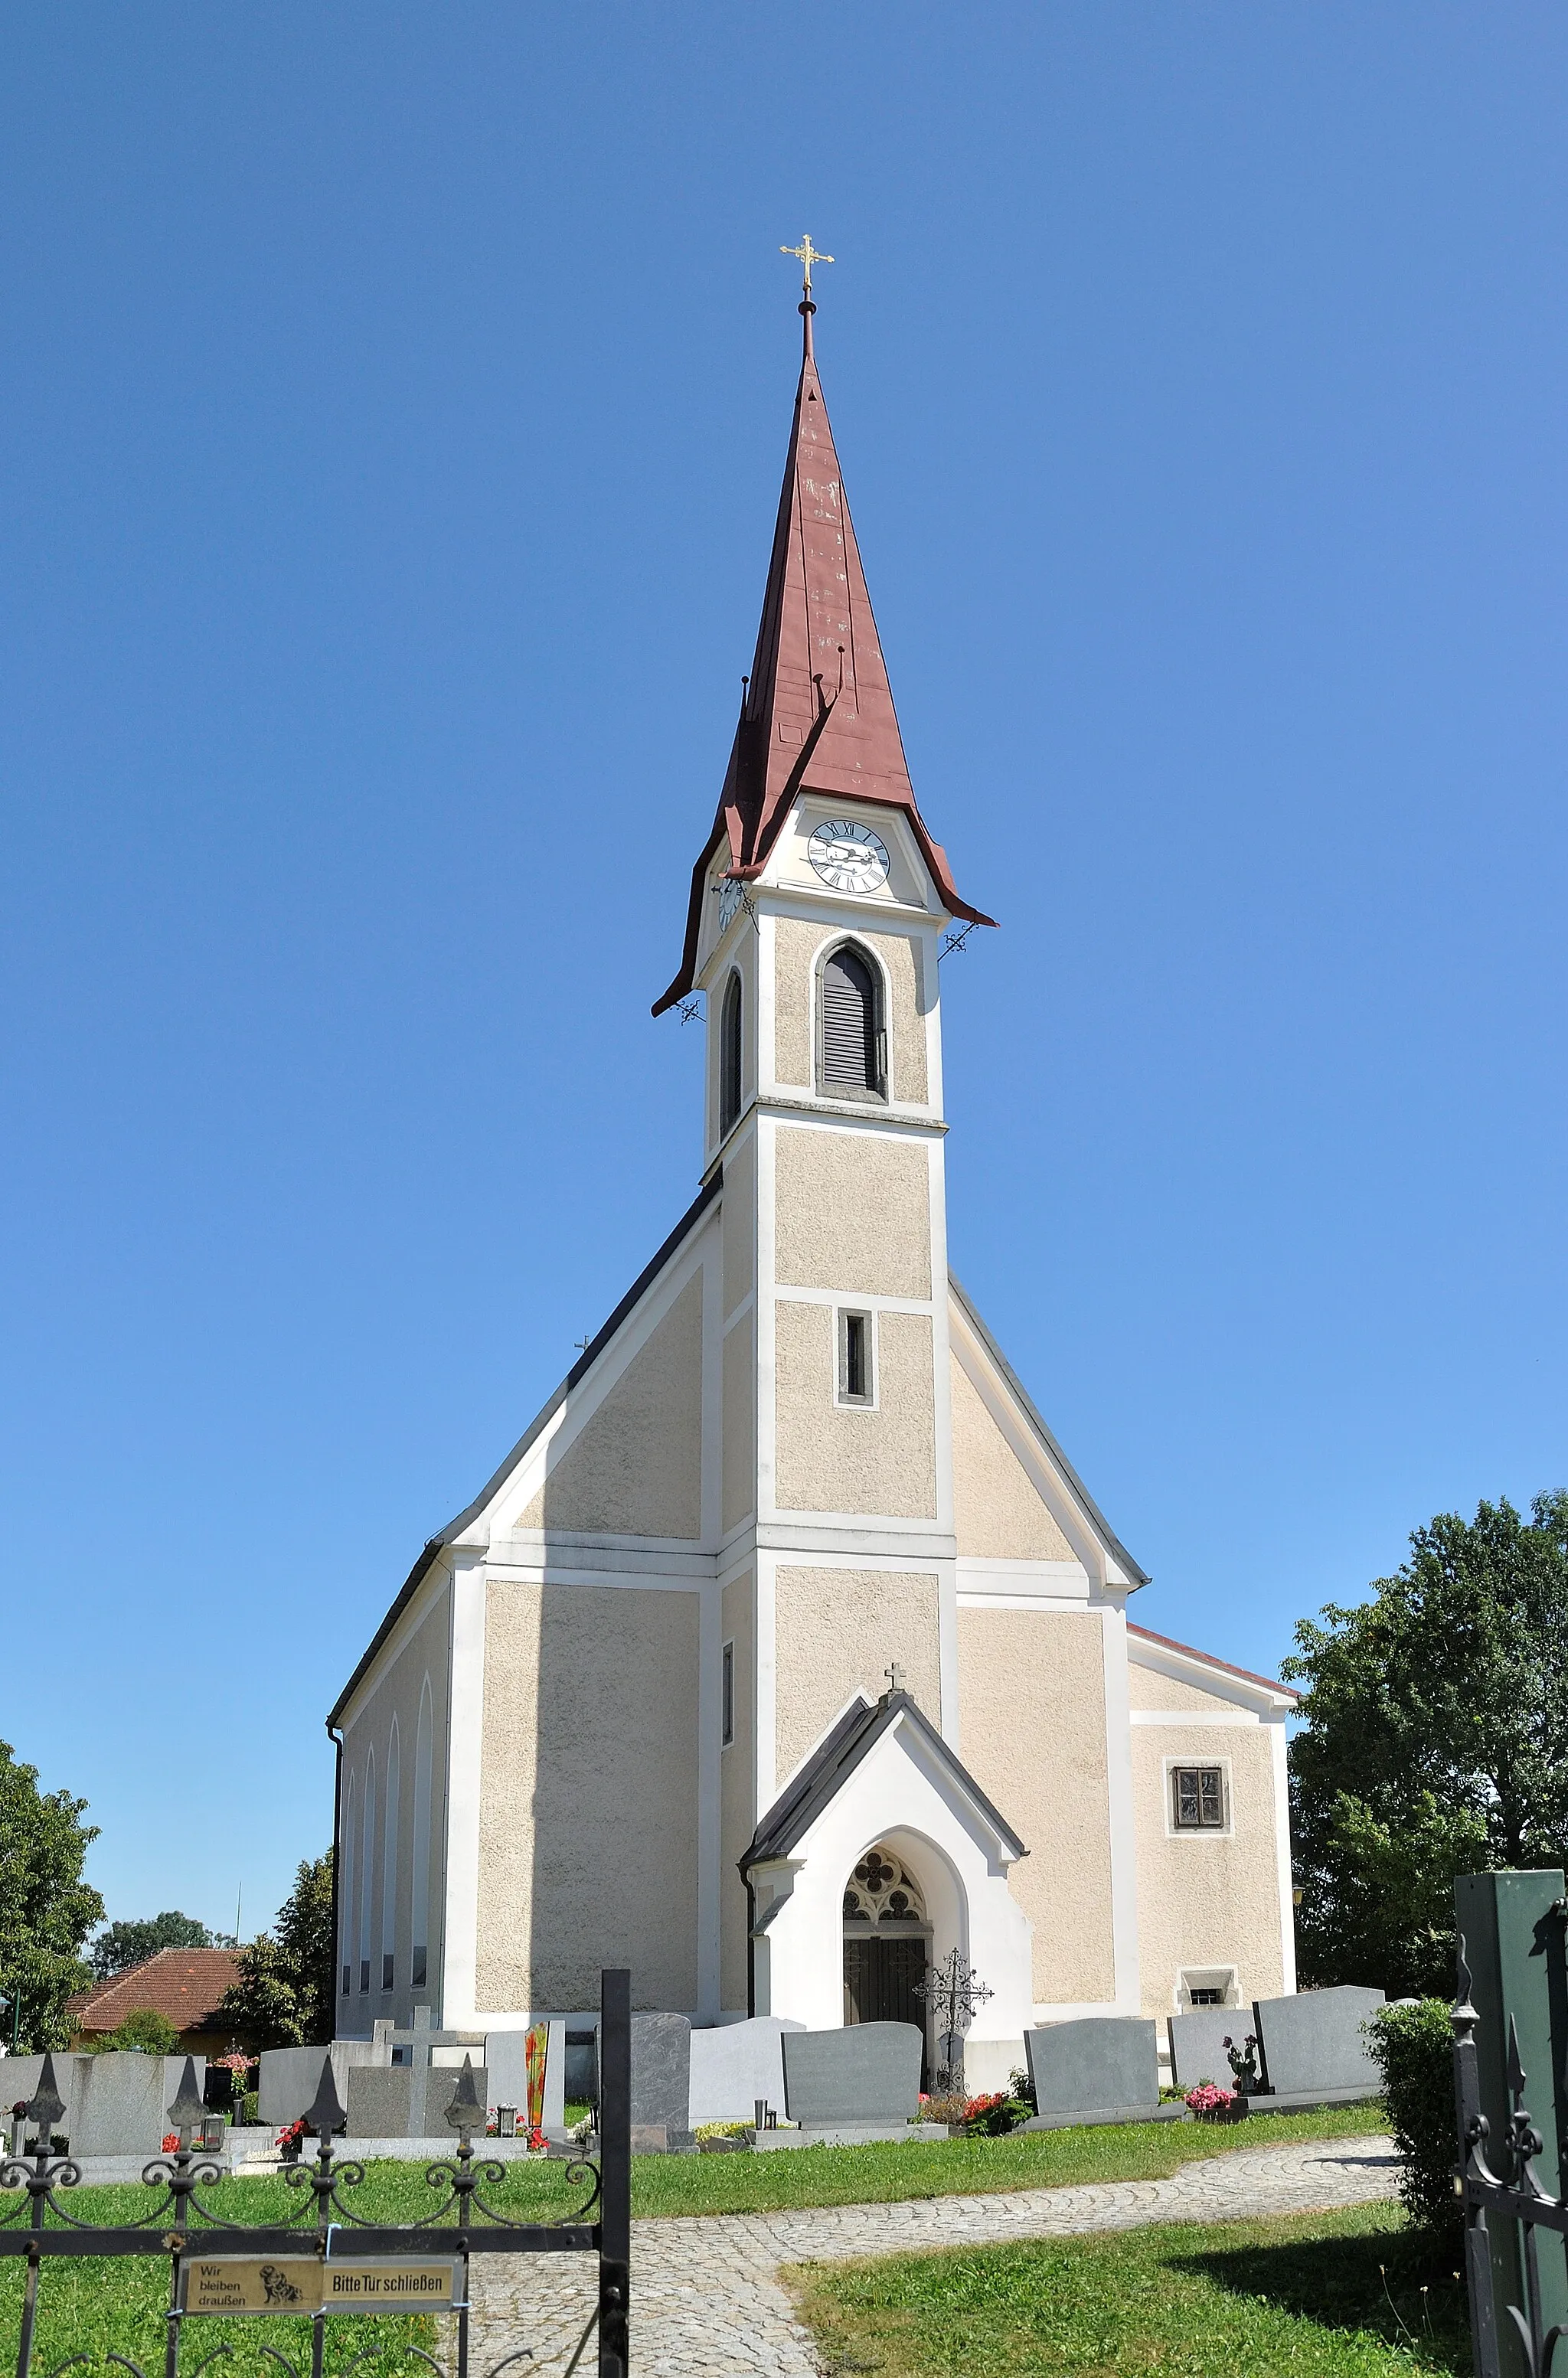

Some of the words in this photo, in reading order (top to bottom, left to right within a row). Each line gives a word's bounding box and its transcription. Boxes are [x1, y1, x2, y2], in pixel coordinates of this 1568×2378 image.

[825, 822, 840, 837] XI
[843, 822, 854, 836] XII
[829, 872, 841, 886] VII
[847, 877, 854, 890] VI
[201, 2265, 221, 2275] Wir
[200, 2280, 240, 2291] bleiben
[332, 2275, 360, 2291] Bitte
[384, 2274, 443, 2291] schließen
[198, 2295, 246, 2305] draußen
